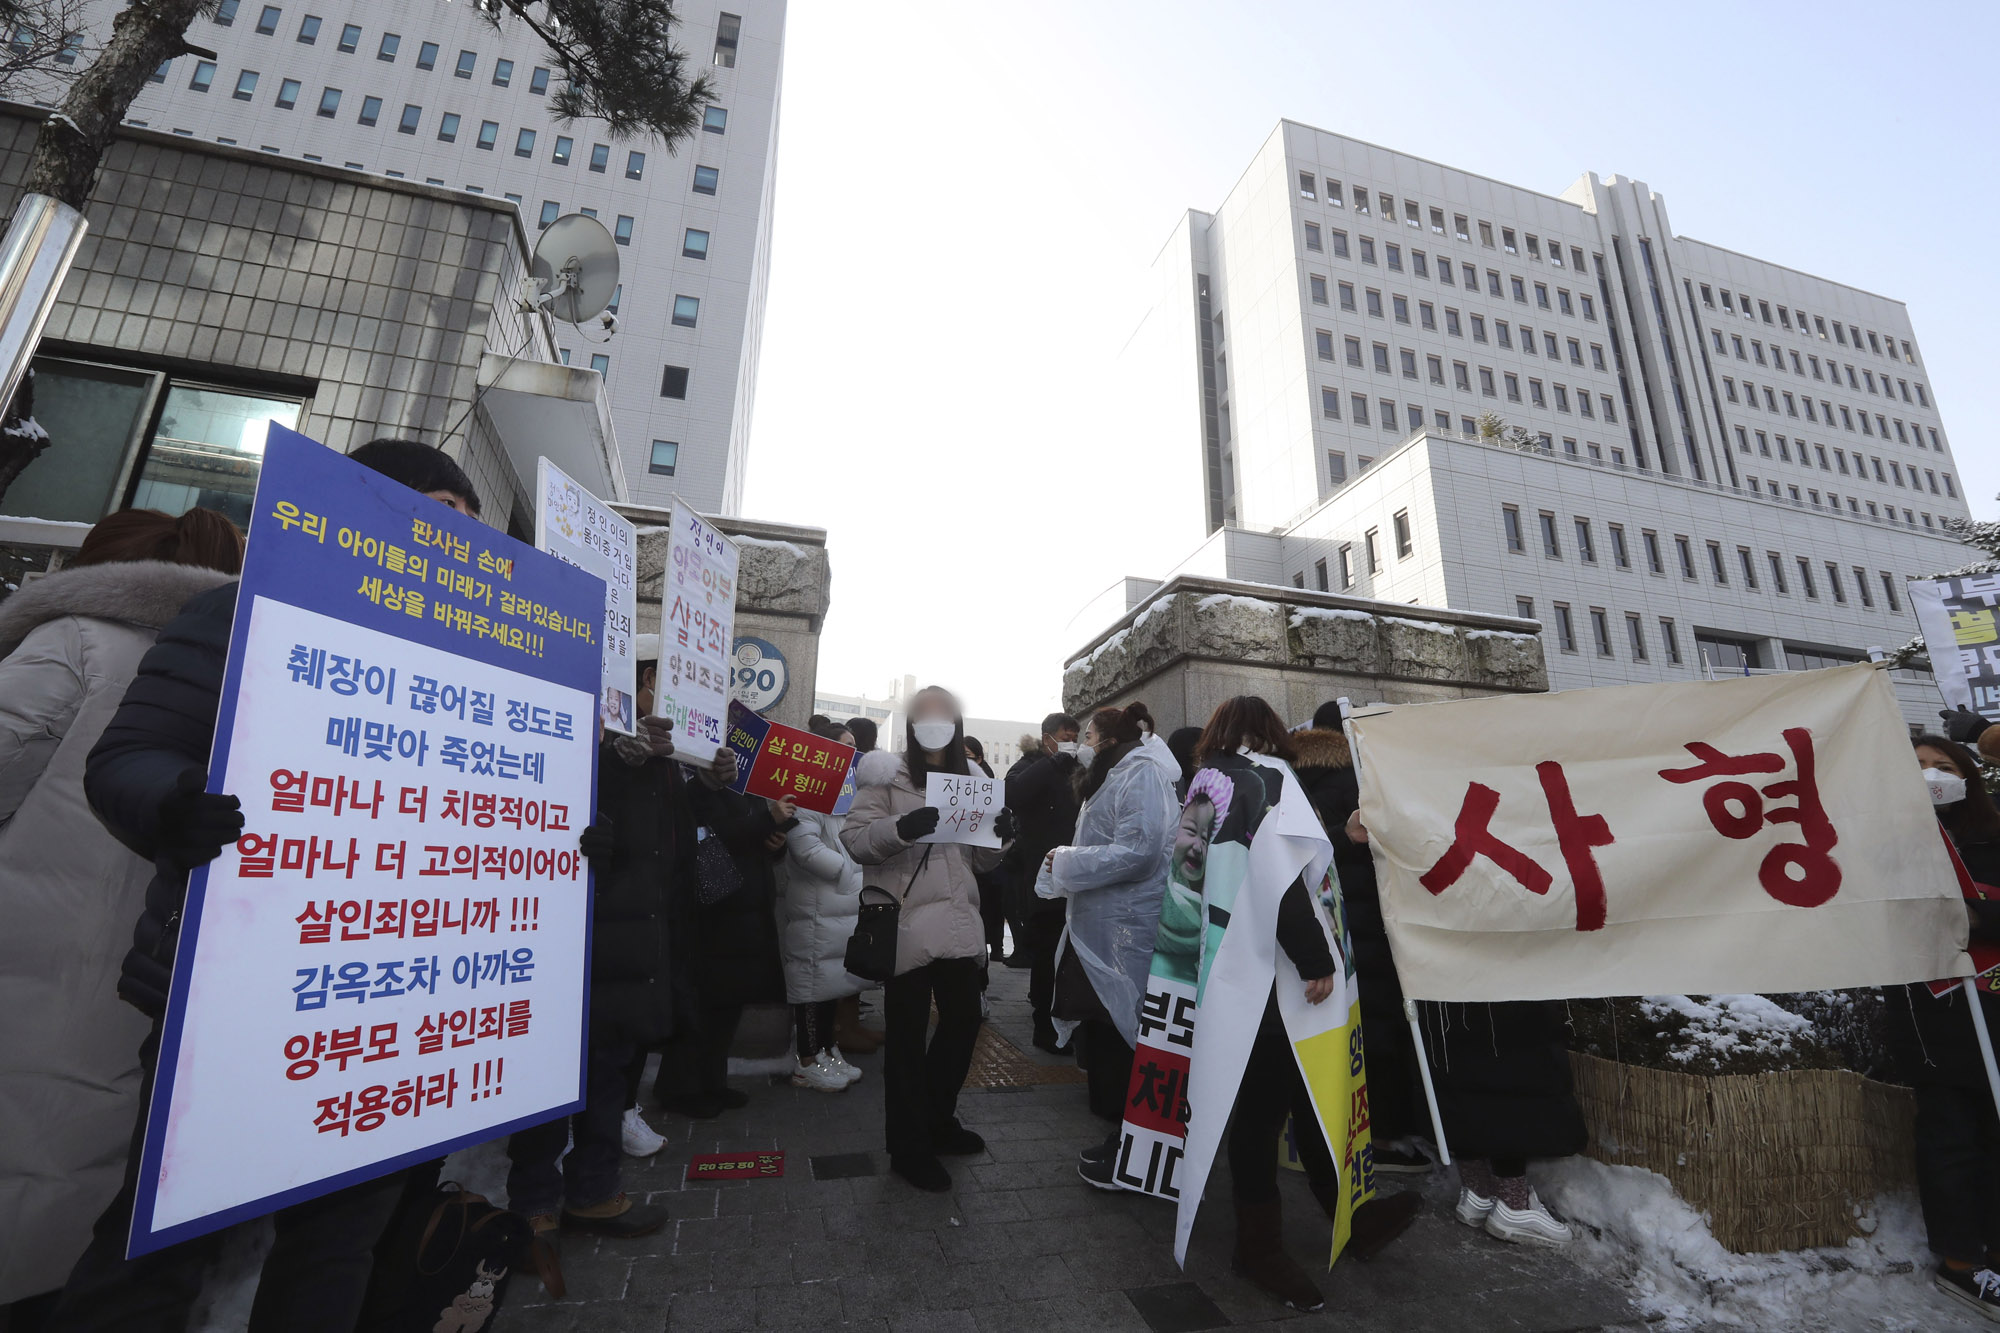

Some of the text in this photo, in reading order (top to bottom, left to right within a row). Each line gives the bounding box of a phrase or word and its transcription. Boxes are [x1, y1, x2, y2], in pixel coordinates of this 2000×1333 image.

[411, 518, 471, 564] 판사님
[477, 548, 514, 581] 손에
[690, 518, 723, 555] 정인이
[272, 500, 596, 645] 우리 아이들의 미래가 걸려있습니다.
[358, 575, 544, 658] 세상을 바꿔주세요!!!
[670, 595, 725, 658] 살인죄
[286, 643, 574, 742] 췌장이 끊어질 정도로
[326, 716, 546, 783] 매맞아 죽었는데
[730, 728, 758, 753] 정인이
[270, 769, 570, 832] 얼마나 더 치명적이고
[943, 779, 992, 806] 장하영
[945, 808, 984, 832] 사형
[236, 832, 580, 881] 얼마나 더 고의적이어야
[295, 897, 499, 944] 살인죄입니까
[292, 948, 535, 1012] 감옥조차 아까운
[283, 999, 532, 1081] 양부모 살인죄를
[313, 1057, 504, 1137] 적용하라 !!!
